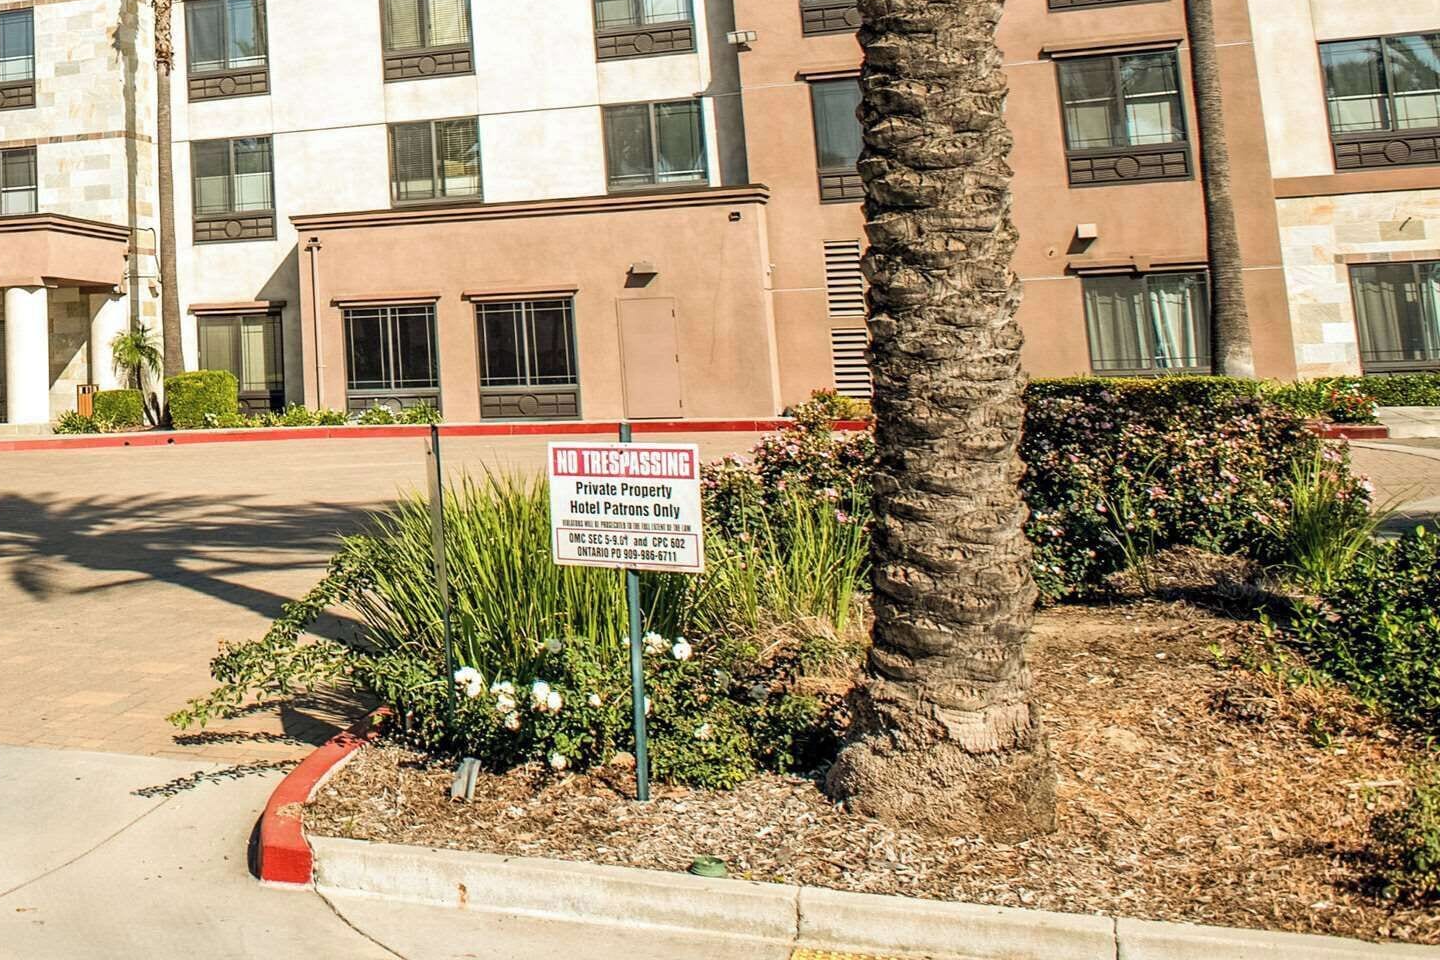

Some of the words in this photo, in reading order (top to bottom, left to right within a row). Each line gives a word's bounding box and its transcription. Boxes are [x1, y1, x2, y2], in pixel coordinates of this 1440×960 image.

[557, 449, 579, 474] NO
[581, 450, 690, 477] TRESPASSING
[576, 481, 617, 496] Private
[621, 483, 672, 499] Property
[570, 500, 600, 515] Hotel
[604, 501, 649, 517] Patrons
[653, 503, 680, 520] Only
[569, 532, 586, 543] OMC
[588, 533, 603, 544] SEC
[633, 536, 648, 547] and
[652, 536, 669, 548] CPC
[577, 545, 609, 558] ONTARIO
[623, 549, 677, 562] 909-986-6711
